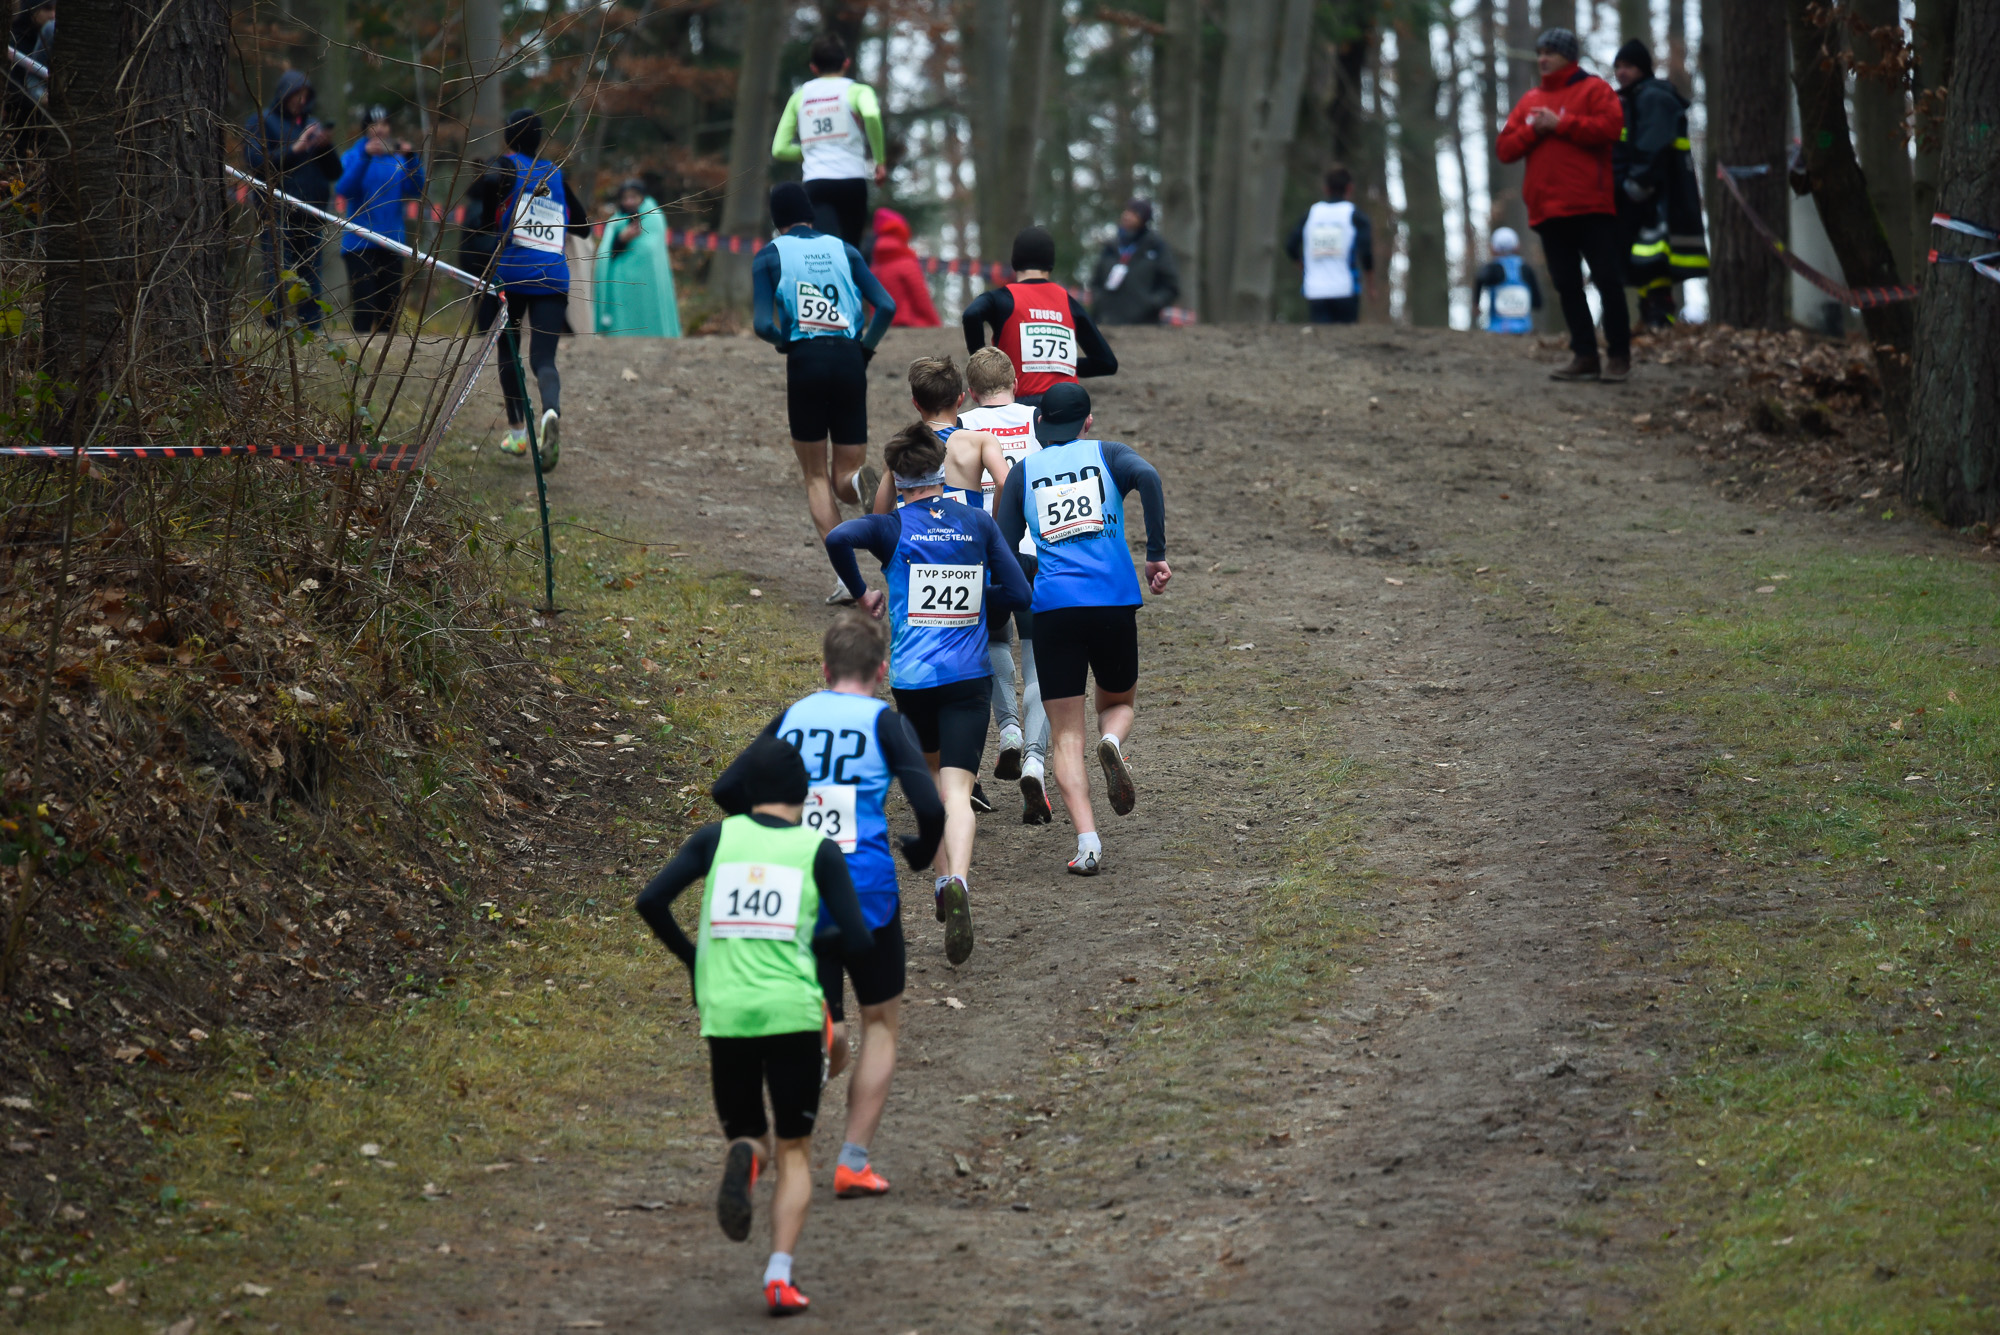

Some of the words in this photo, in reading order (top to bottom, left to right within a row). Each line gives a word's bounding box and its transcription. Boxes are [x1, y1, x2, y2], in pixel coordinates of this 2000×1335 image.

[812, 117, 833, 135] 38
[523, 218, 555, 241] 406
[801, 299, 840, 322] 598
[1028, 308, 1063, 323] TRUSO
[1032, 339, 1069, 360] 575
[1047, 495, 1093, 526] 528
[910, 534, 951, 542] ATHLETICS
[951, 534, 973, 542] TEAM
[1045, 529, 1072, 542] OMASZÓW
[917, 570, 939, 579] TVP
[942, 570, 978, 580] SPORT
[920, 585, 970, 611] 242
[727, 889, 782, 917] 140
